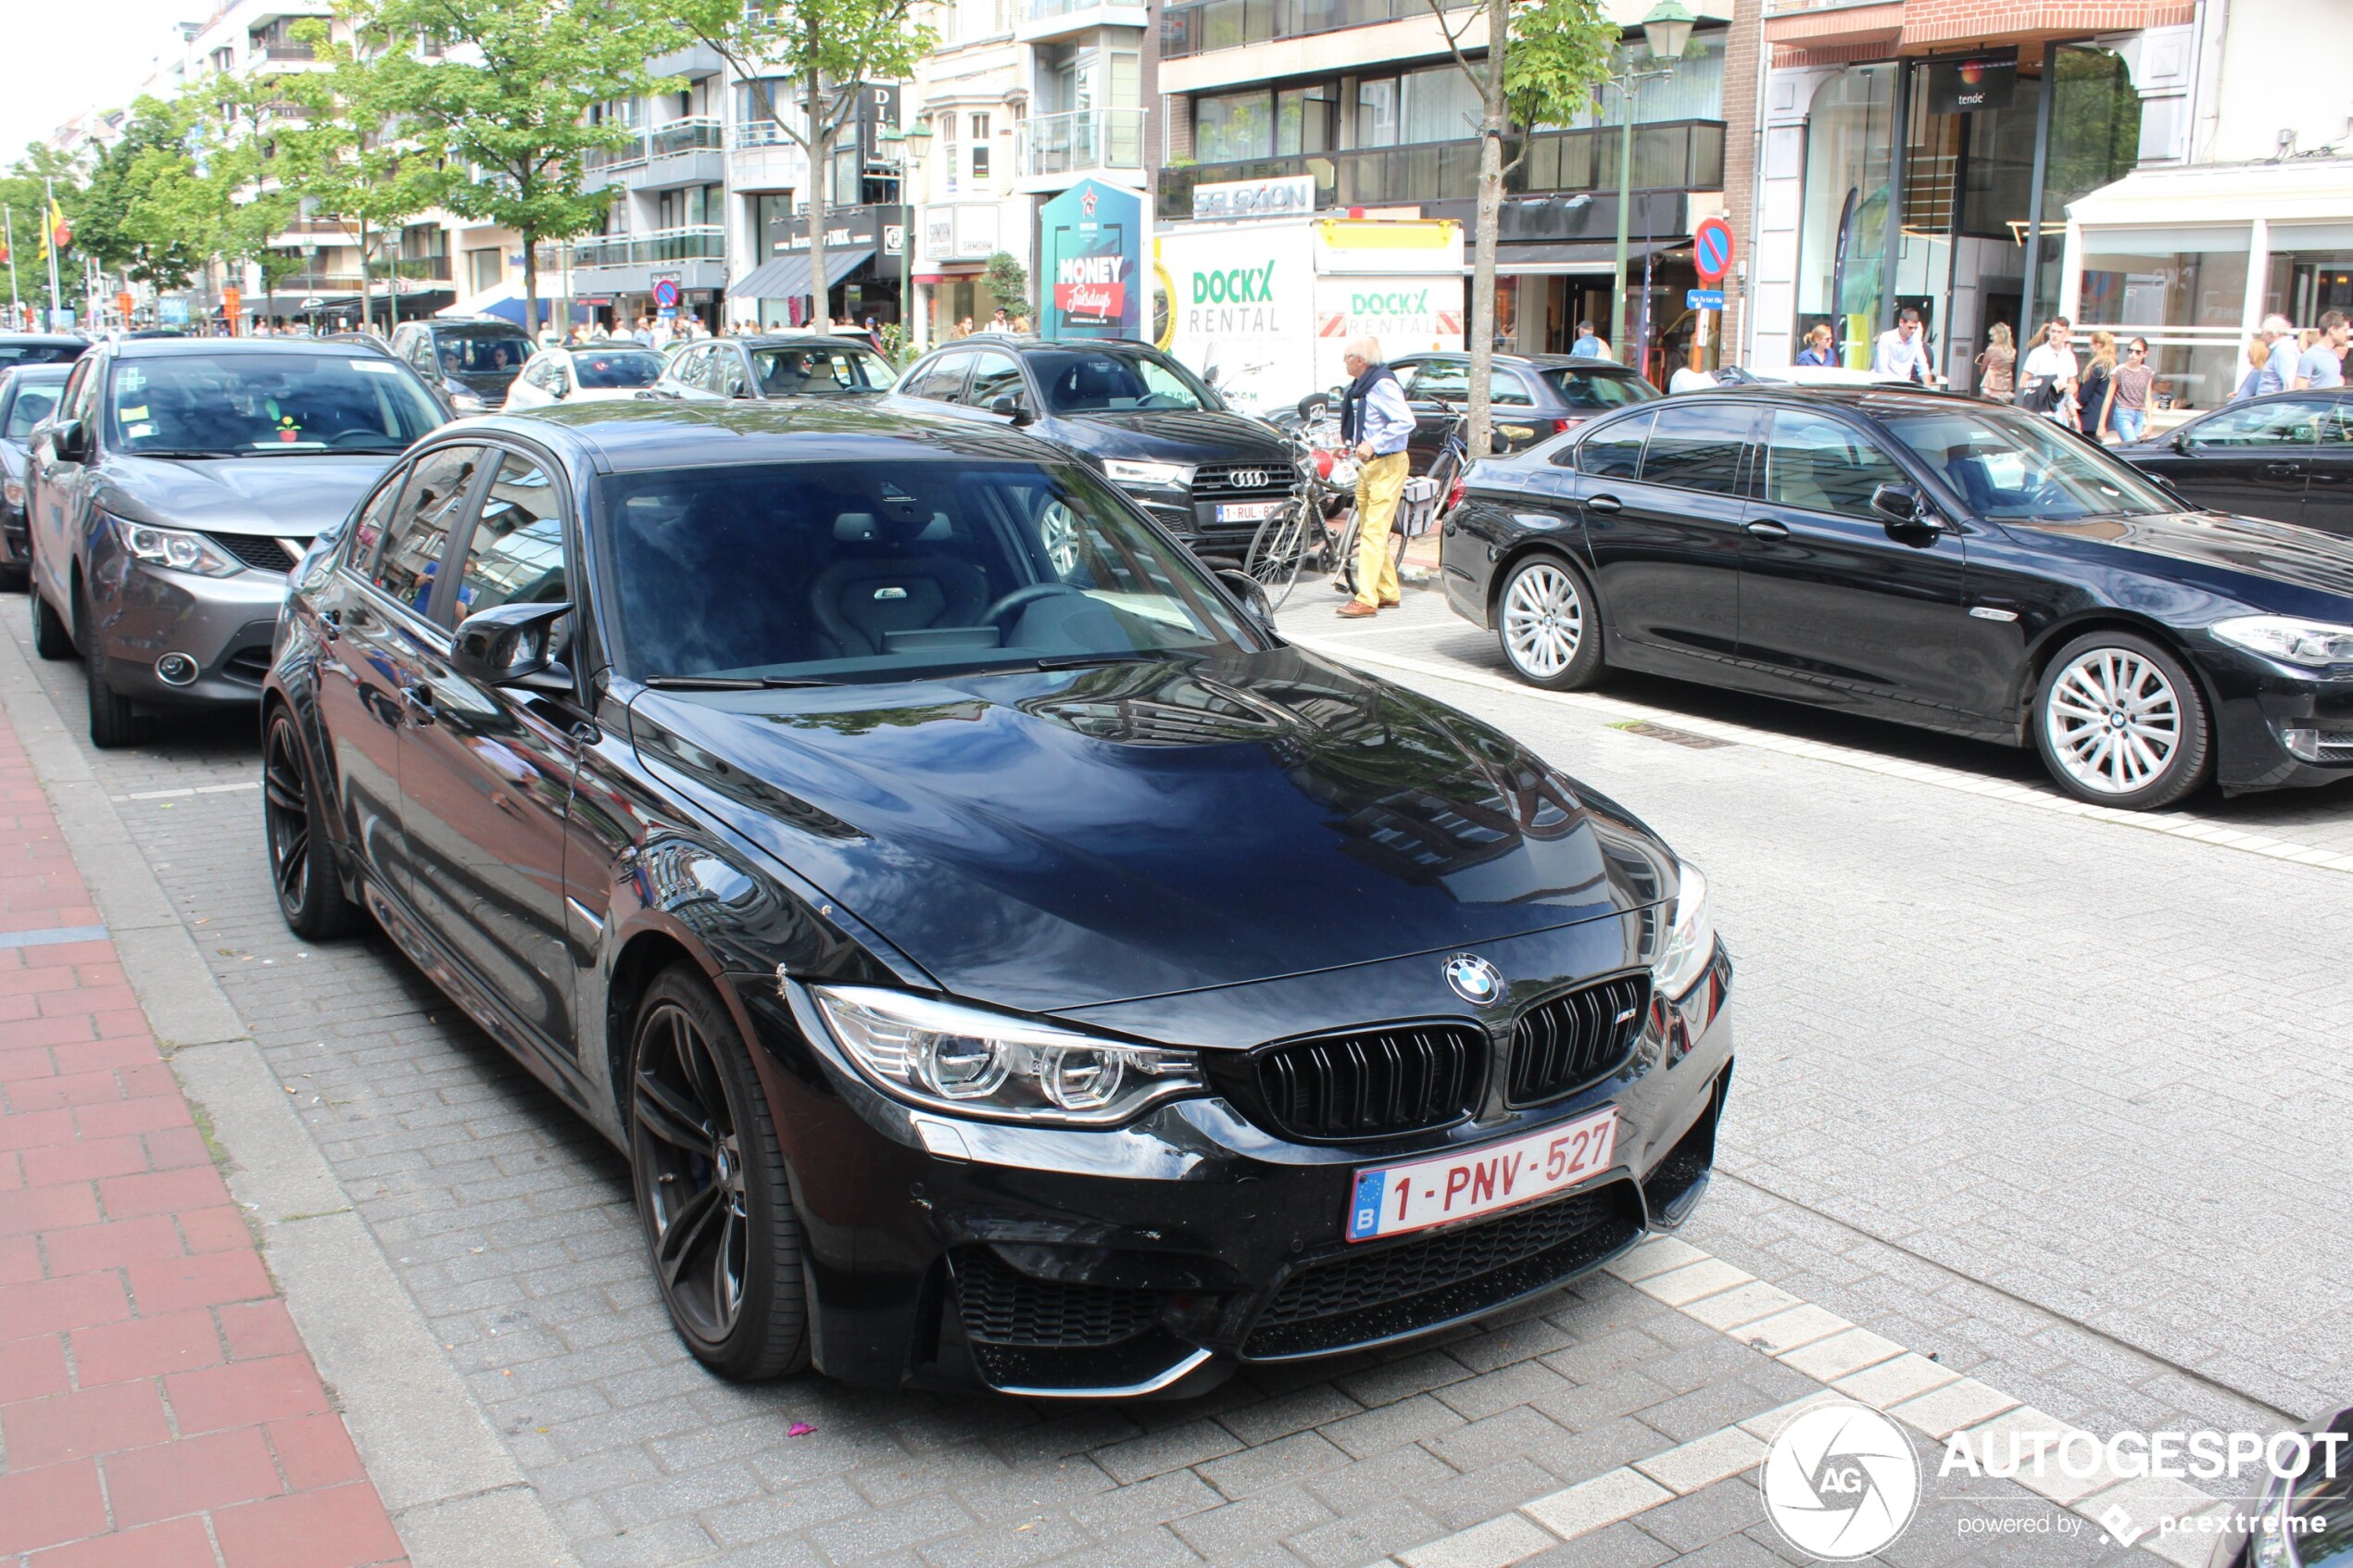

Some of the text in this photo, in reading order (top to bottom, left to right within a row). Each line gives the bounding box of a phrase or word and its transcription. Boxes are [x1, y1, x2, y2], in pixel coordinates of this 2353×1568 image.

[828, 229, 850, 245] DIRK
[963, 241, 992, 251] SAMDAM
[1060, 256, 1124, 284] MONEY
[1193, 259, 1276, 304] DOCKX
[1067, 284, 1112, 318] Tuesdays
[1352, 288, 1428, 315] DOCKX
[1189, 307, 1279, 332] RENTAL
[1349, 318, 1434, 334] RENTAL
[1449, 960, 1486, 977] BMW
[1394, 1121, 1610, 1221] 1-PNV-527
[1357, 1209, 1374, 1231] B
